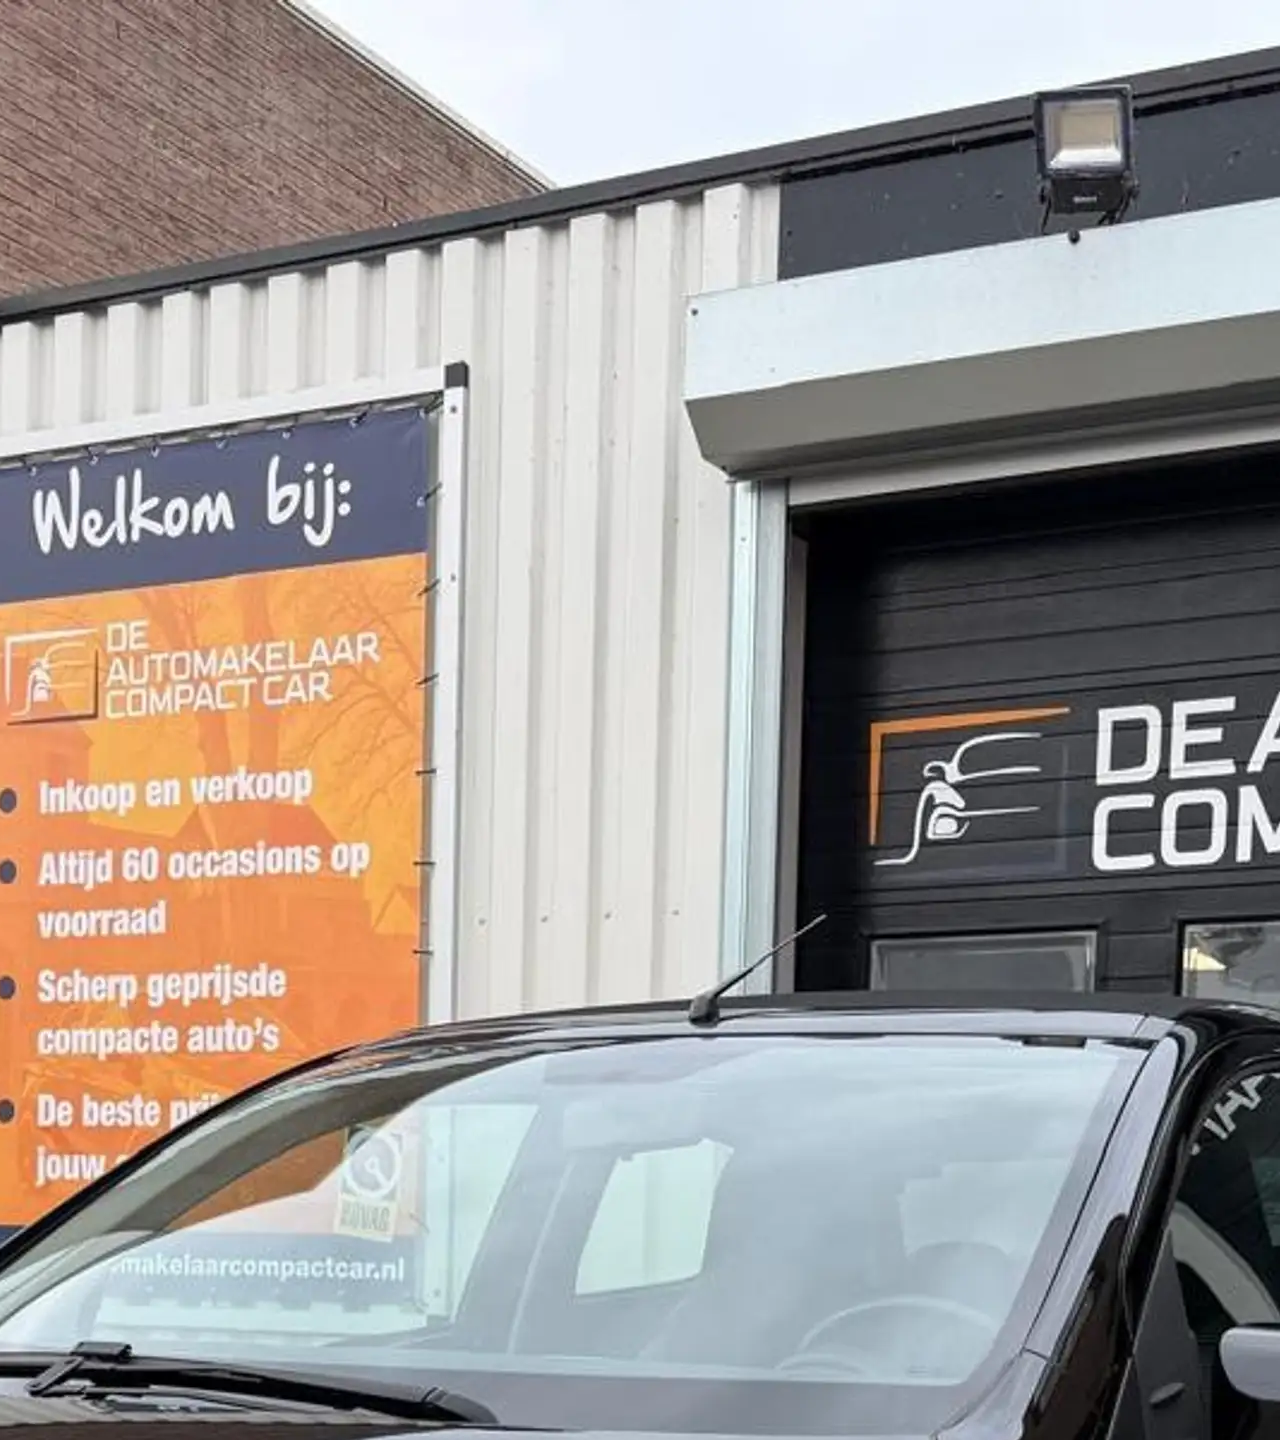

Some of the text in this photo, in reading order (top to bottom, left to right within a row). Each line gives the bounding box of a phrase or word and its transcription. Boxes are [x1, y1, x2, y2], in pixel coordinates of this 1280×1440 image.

[33, 455, 352, 554] Welkom bij:
[106, 619, 149, 653] DE
[105, 631, 381, 687] AUTOMAKELAAR
[106, 671, 333, 720] COMPACT CAR
[1095, 696, 1237, 786] DE
[39, 766, 313, 815] Inkoop en verkoop
[37, 840, 370, 890] Altijd 60 occasions op
[37, 900, 167, 938] voorraad
[37, 964, 287, 1008] Scherp geprijsde
[37, 1018, 280, 1059] compacte auto's
[37, 1093, 72, 1126] De
[82, 1093, 160, 1127] beste
[35, 1145, 106, 1186] jouw
[112, 1253, 404, 1284] makelaarcompactcar.nl
